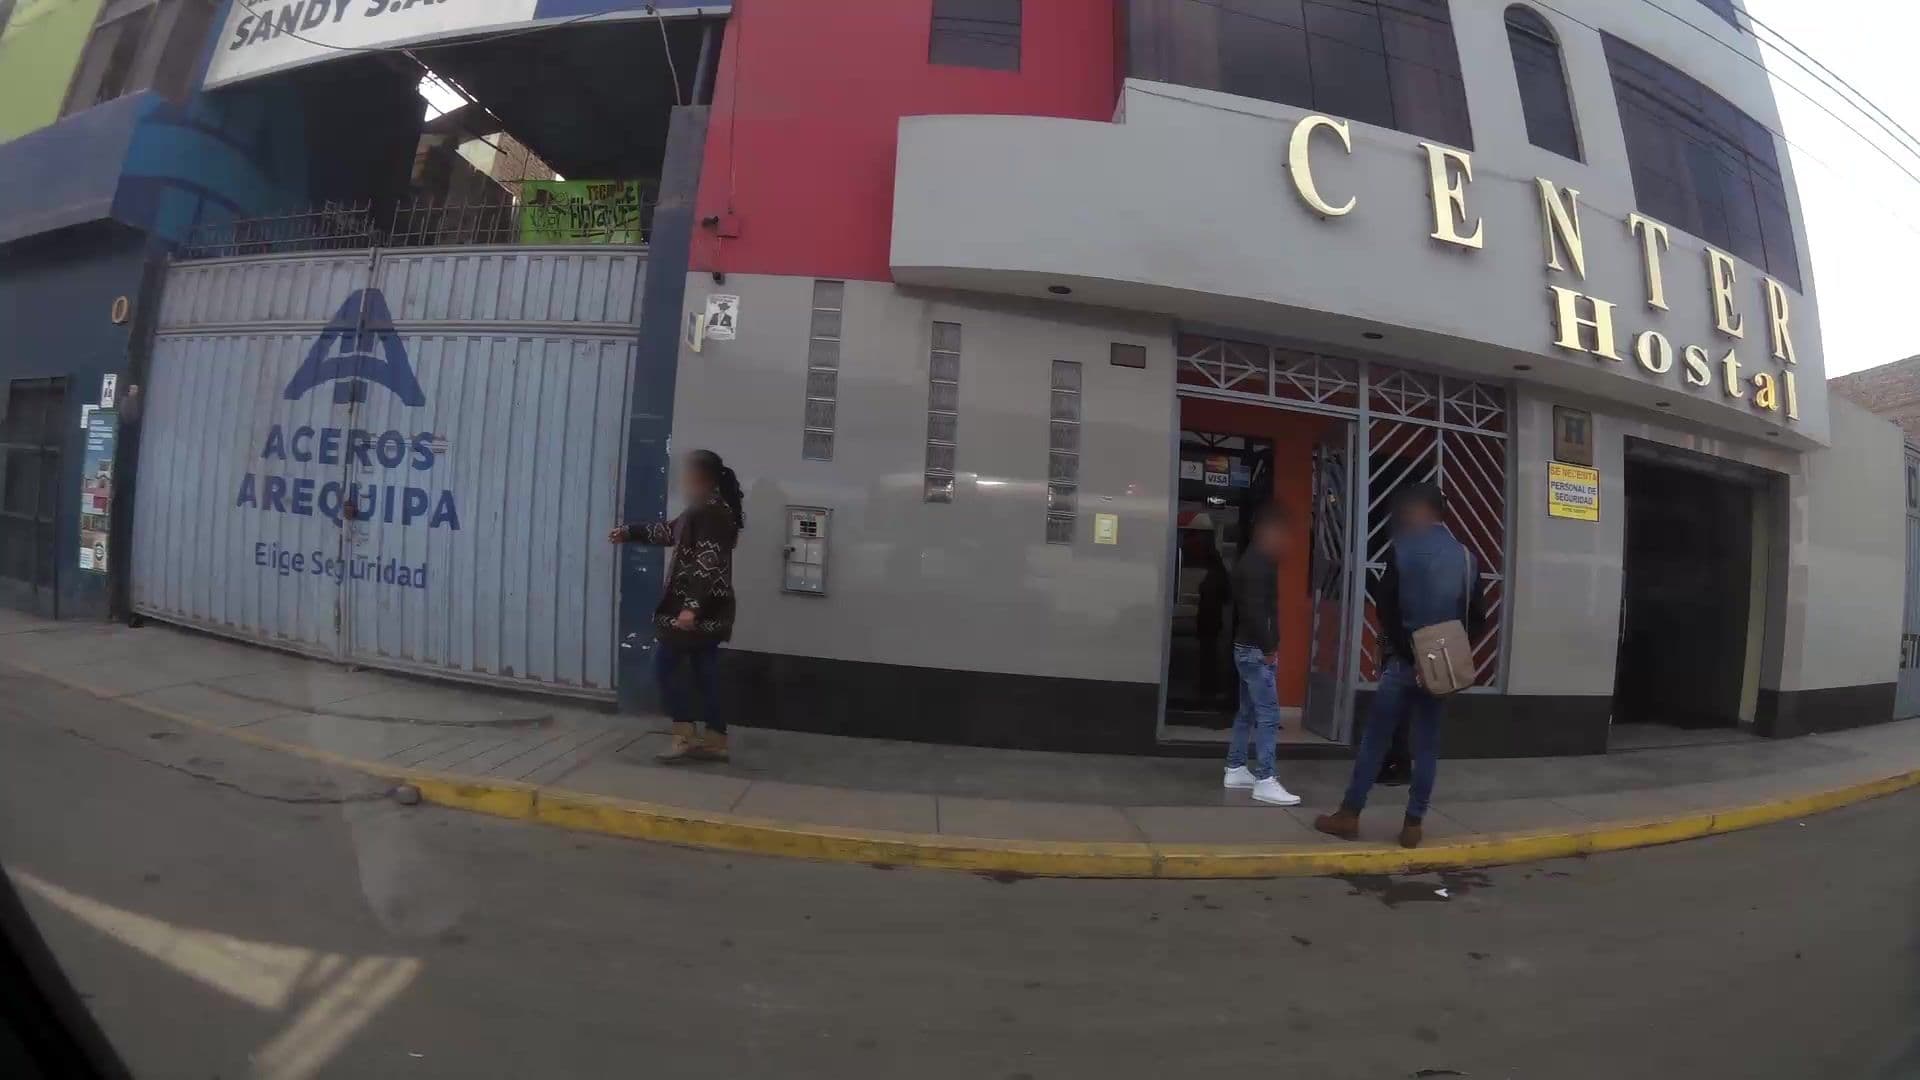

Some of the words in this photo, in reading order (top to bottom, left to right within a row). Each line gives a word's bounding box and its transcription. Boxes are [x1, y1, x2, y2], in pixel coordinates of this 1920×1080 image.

[230, 0, 350, 50] SANDY
[1288, 115, 1797, 366] CENTER
[1547, 285, 1800, 422] Hostal
[261, 424, 436, 471] ACEROS
[236, 472, 461, 531] AREQUIPA
[1207, 475, 1227, 484] VISA
[1551, 481, 1586, 494] PERSONAL
[1555, 492, 1593, 505] SEGURIDAD
[311, 550, 427, 588] Seguridad
